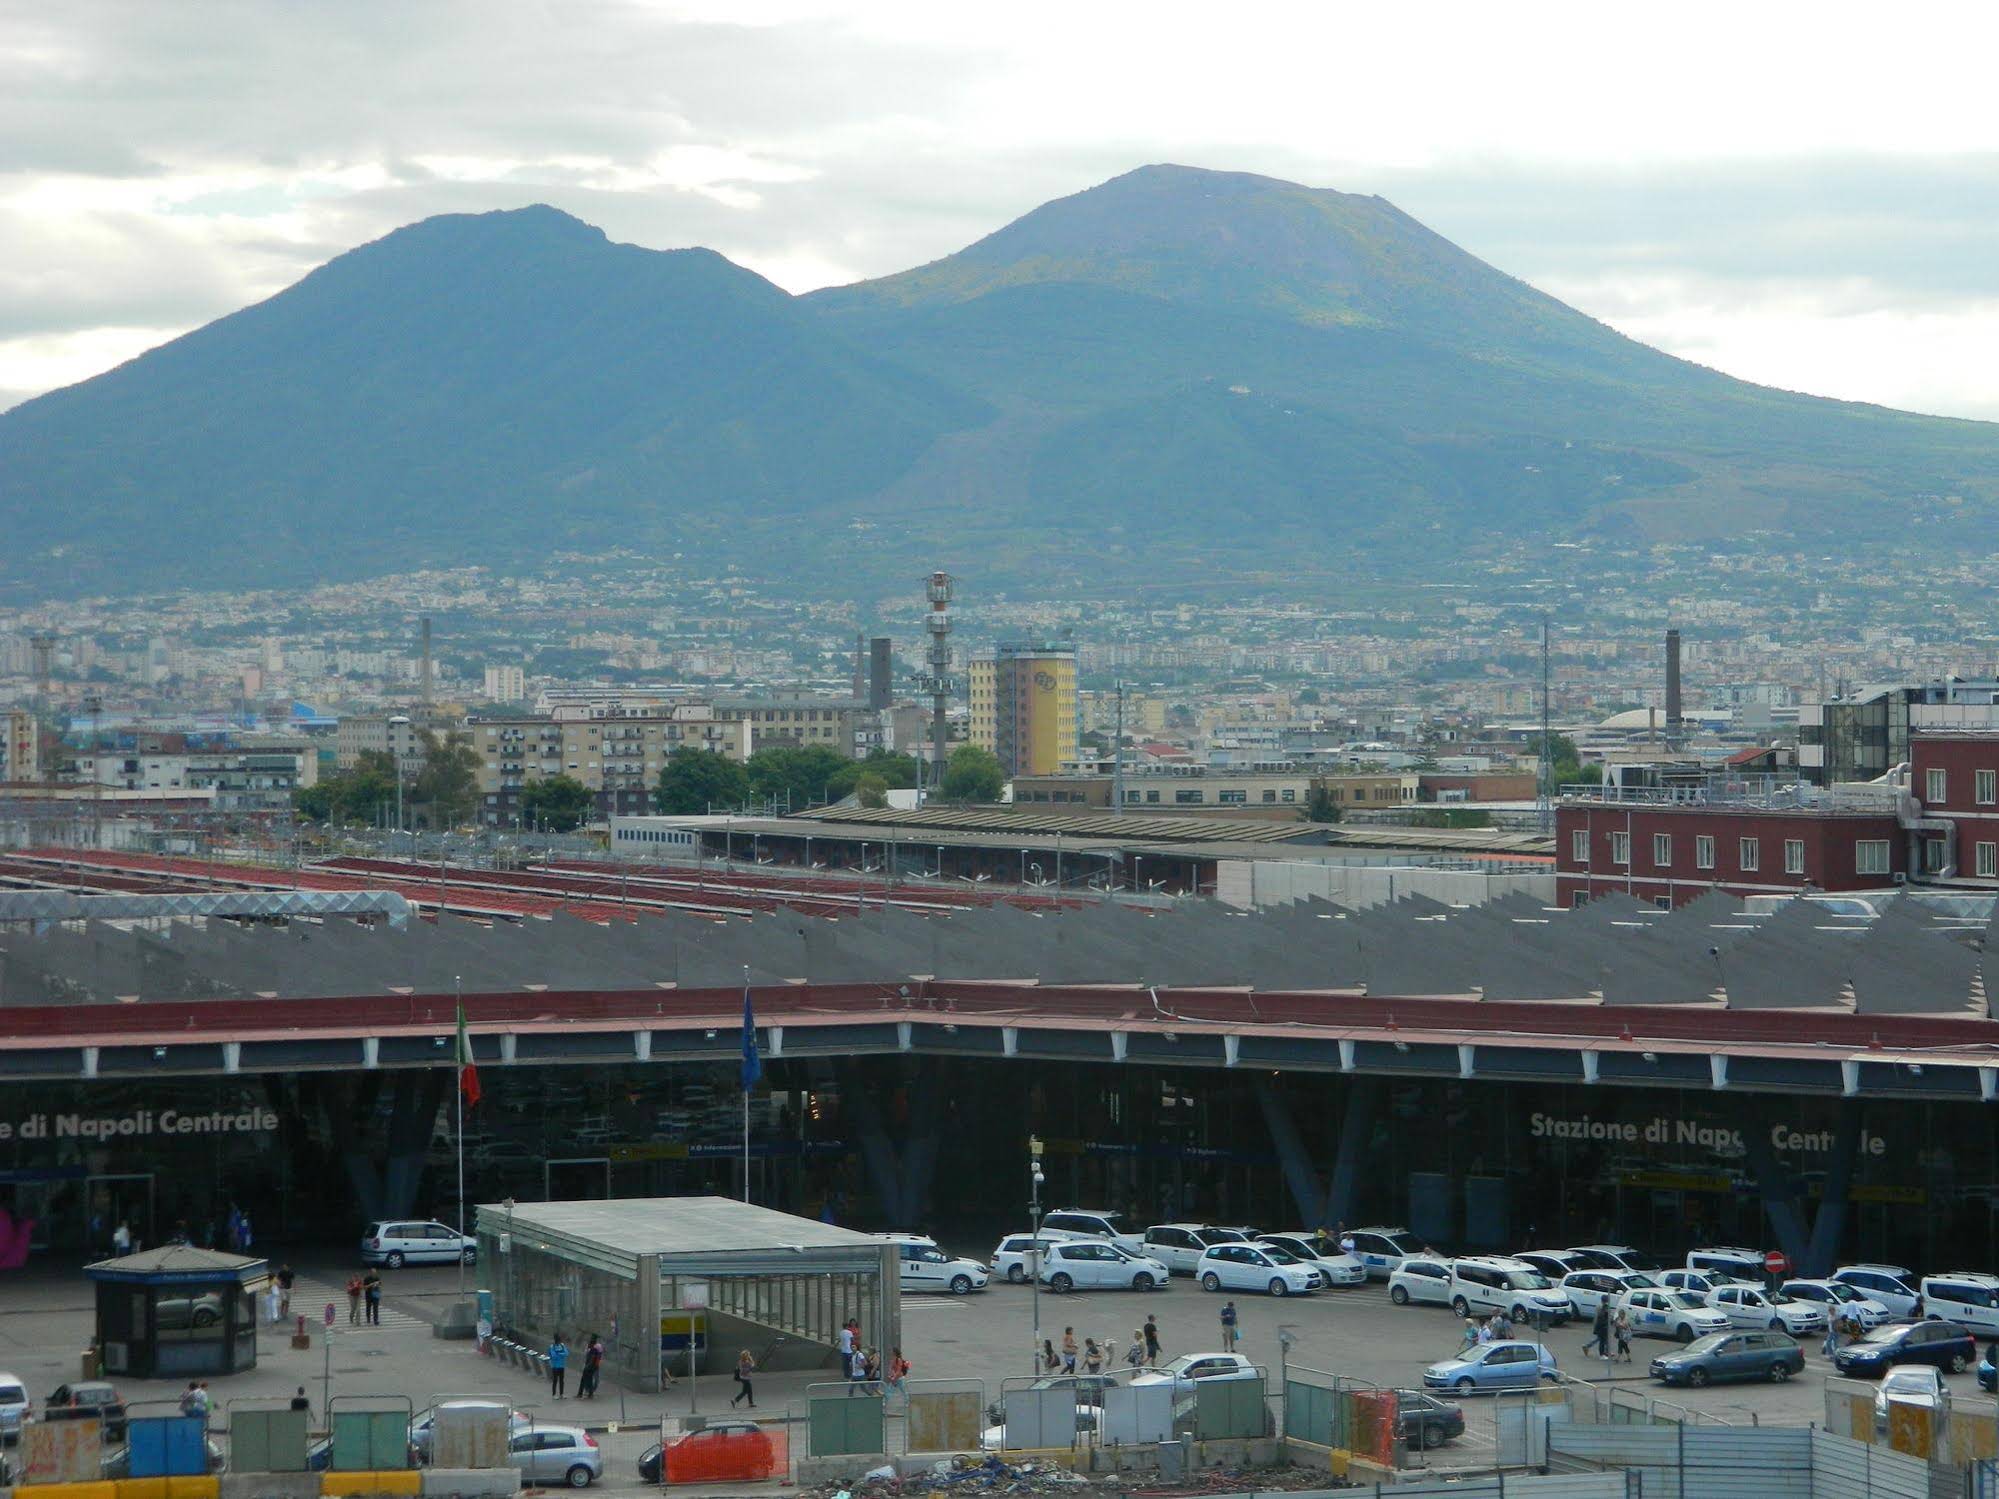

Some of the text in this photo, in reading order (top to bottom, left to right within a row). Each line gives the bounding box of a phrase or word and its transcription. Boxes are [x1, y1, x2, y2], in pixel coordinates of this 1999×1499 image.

[20, 1113, 47, 1139] di
[56, 1110, 152, 1141] Napoli
[159, 1107, 279, 1134] Centrale
[1530, 1112, 1885, 1155] Stazione di Napo Centle
